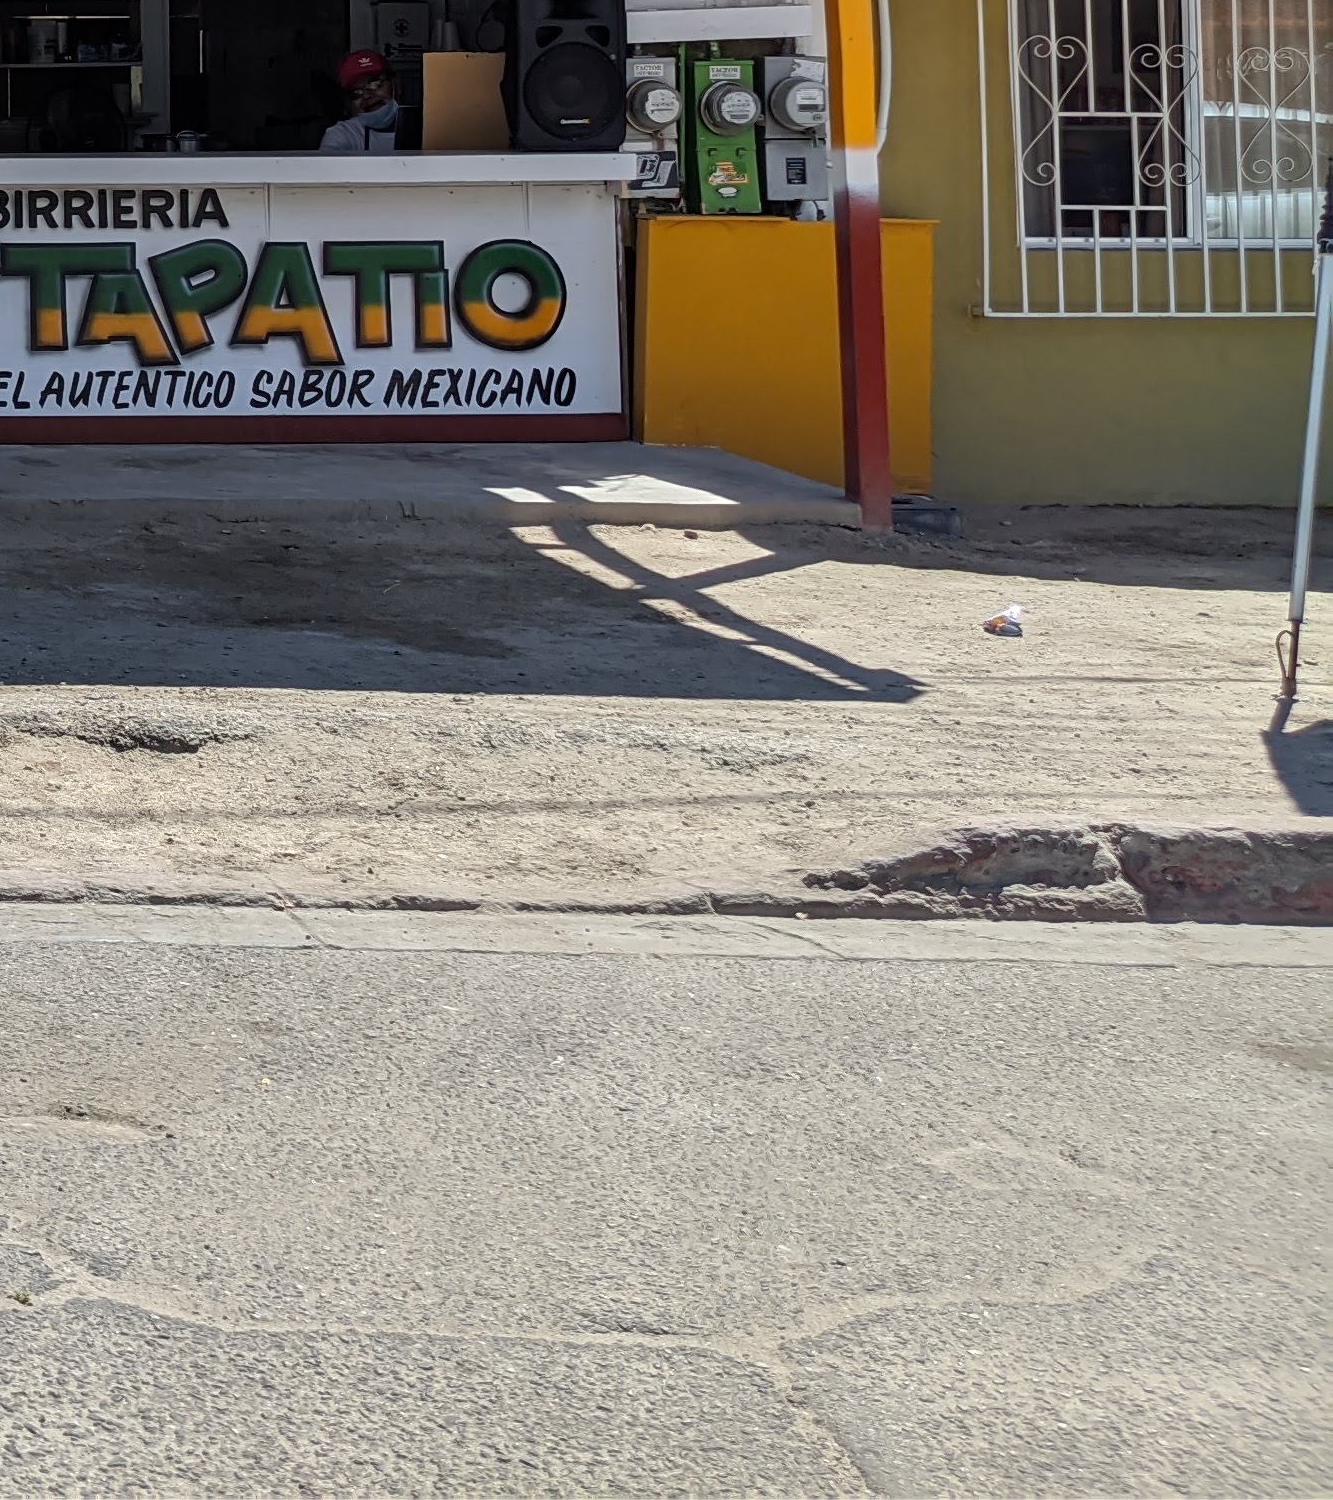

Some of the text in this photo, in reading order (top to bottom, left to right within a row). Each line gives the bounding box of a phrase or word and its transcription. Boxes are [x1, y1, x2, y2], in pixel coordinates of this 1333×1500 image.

[0, 238, 568, 367] TAPATIO
[39, 370, 236, 410] AUTENTICO
[250, 369, 372, 409] SABOR
[384, 367, 577, 409] MEXICANO
